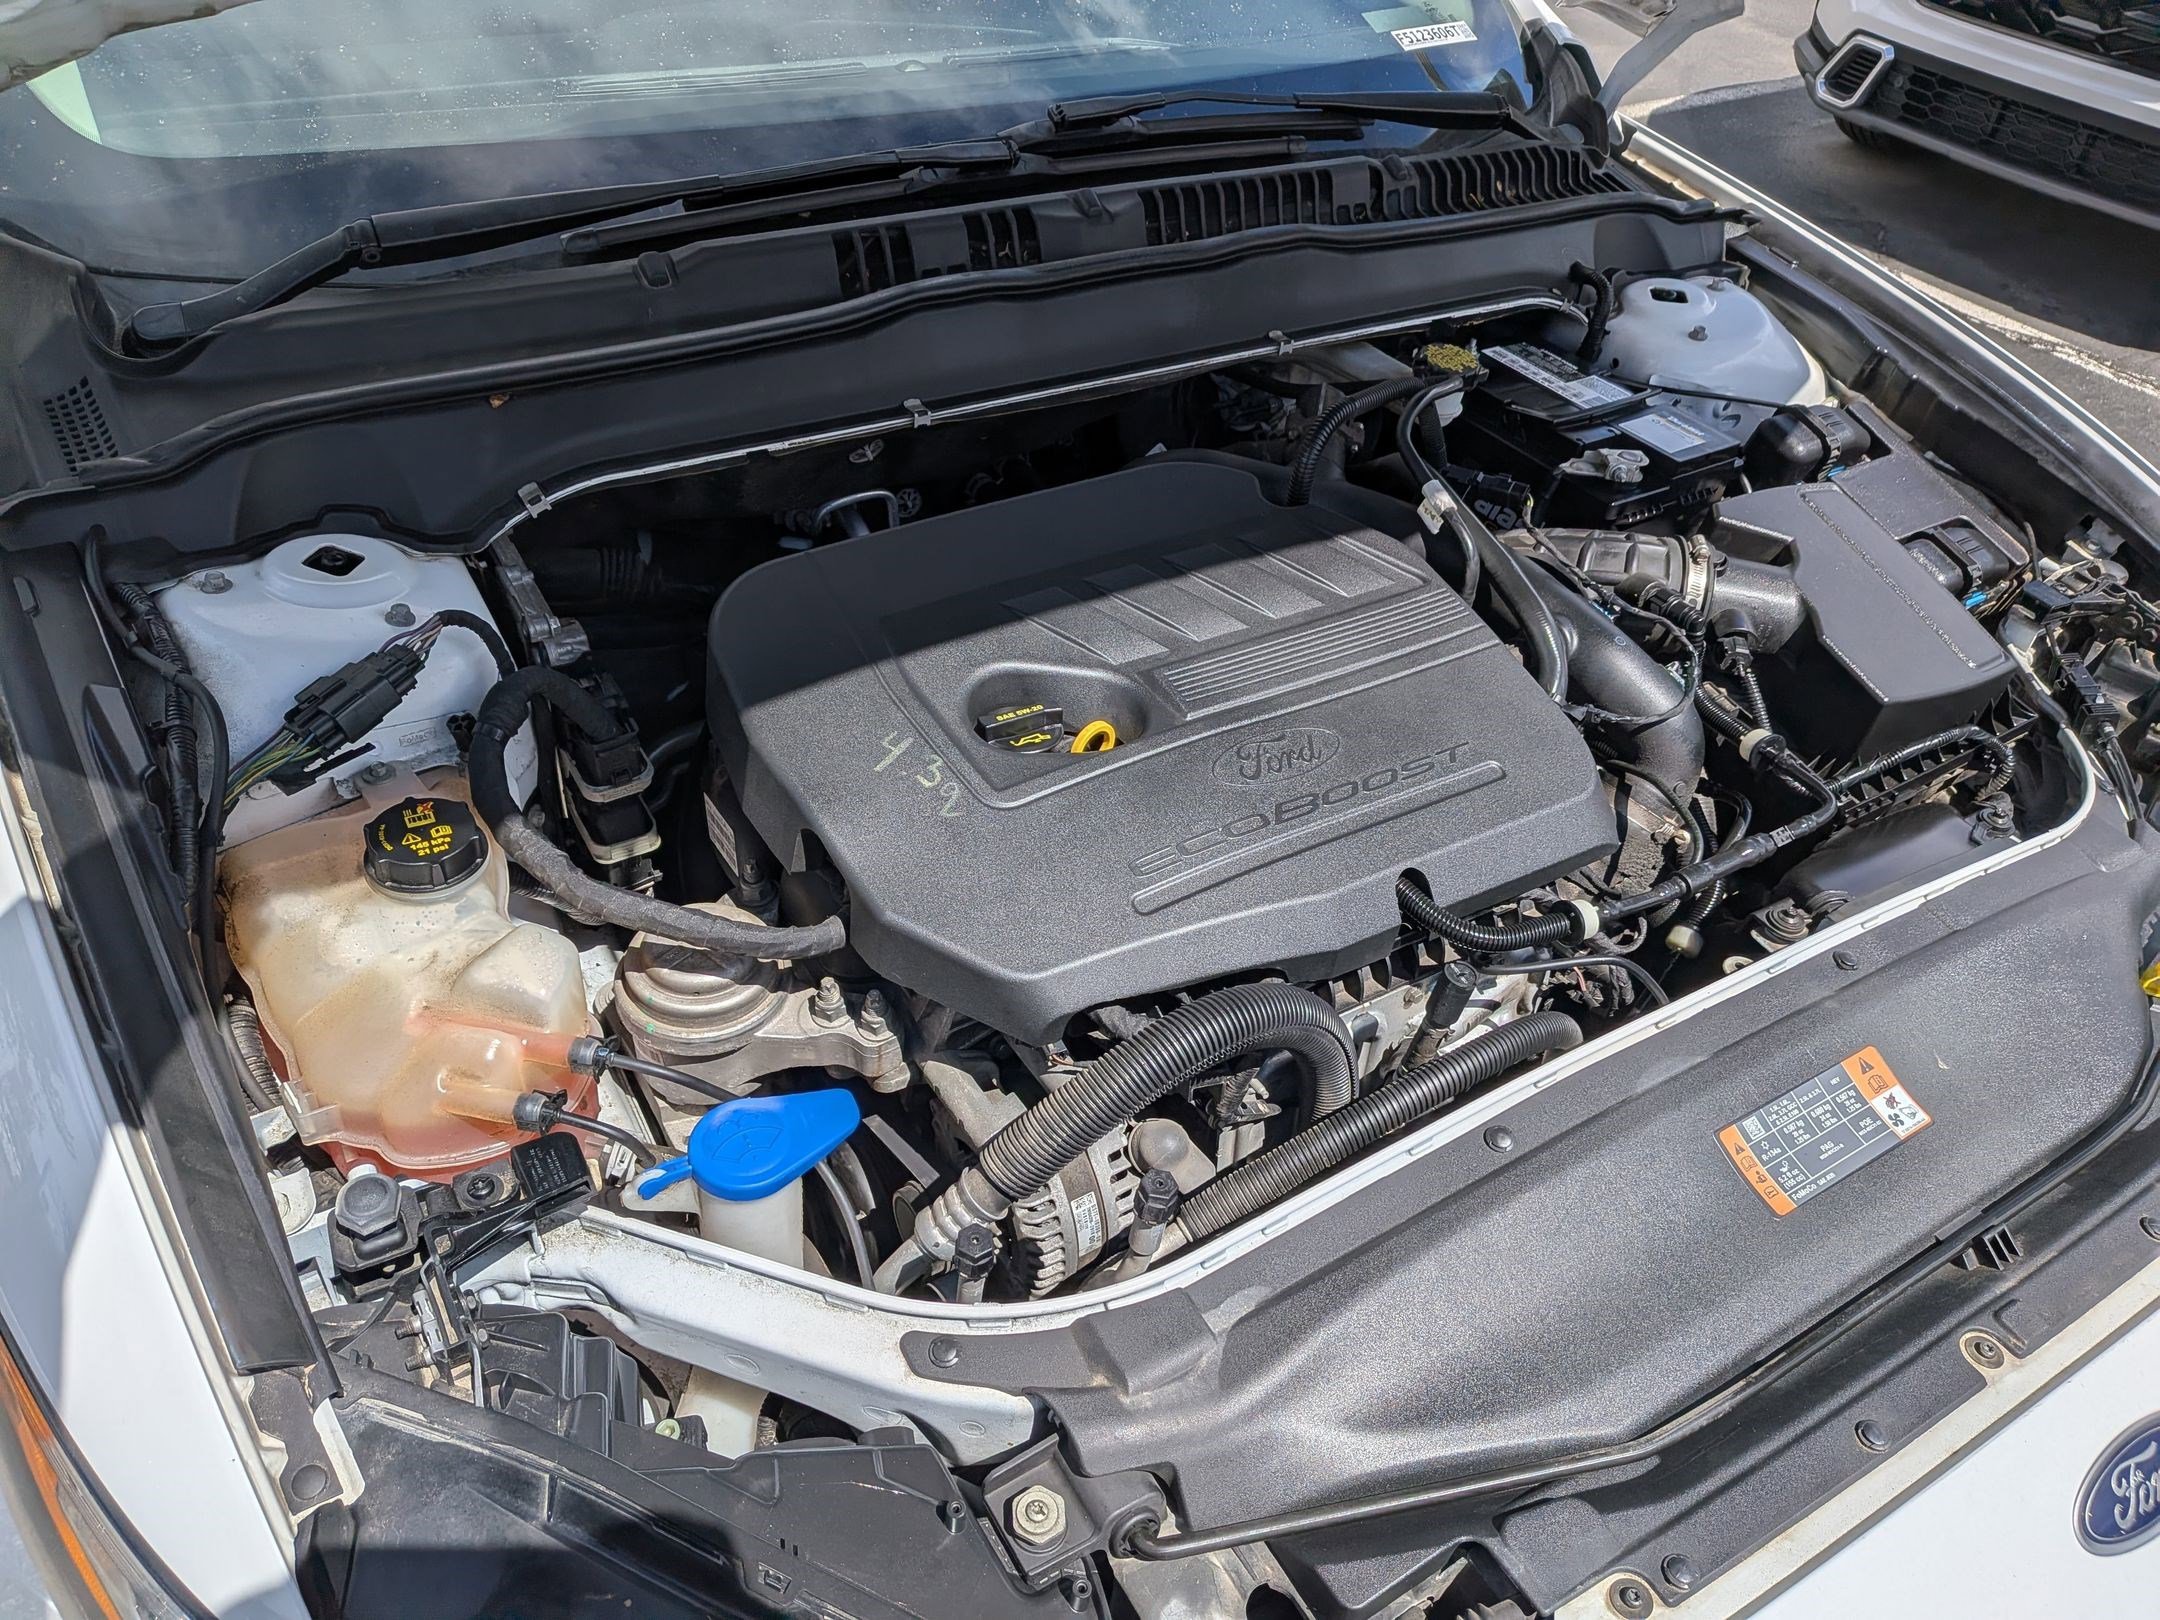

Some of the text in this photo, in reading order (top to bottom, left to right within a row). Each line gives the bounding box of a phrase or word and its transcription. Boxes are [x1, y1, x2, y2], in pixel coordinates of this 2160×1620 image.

[1016, 704, 1044, 715] 5W-20
[1236, 733, 1322, 781] Ford
[1128, 741, 1470, 878] ECOBOOST
[430, 837, 451, 846] kPa
[417, 844, 449, 857] 21 psi
[1859, 1117, 1873, 1128] POE
[1820, 1141, 1834, 1151] PAG
[1762, 1148, 1781, 1161] R-134a
[1778, 1175, 1788, 1183] 5.2
[1784, 1173, 1806, 1189] (155 cc)
[1792, 1184, 1817, 1200] FoMoCo
